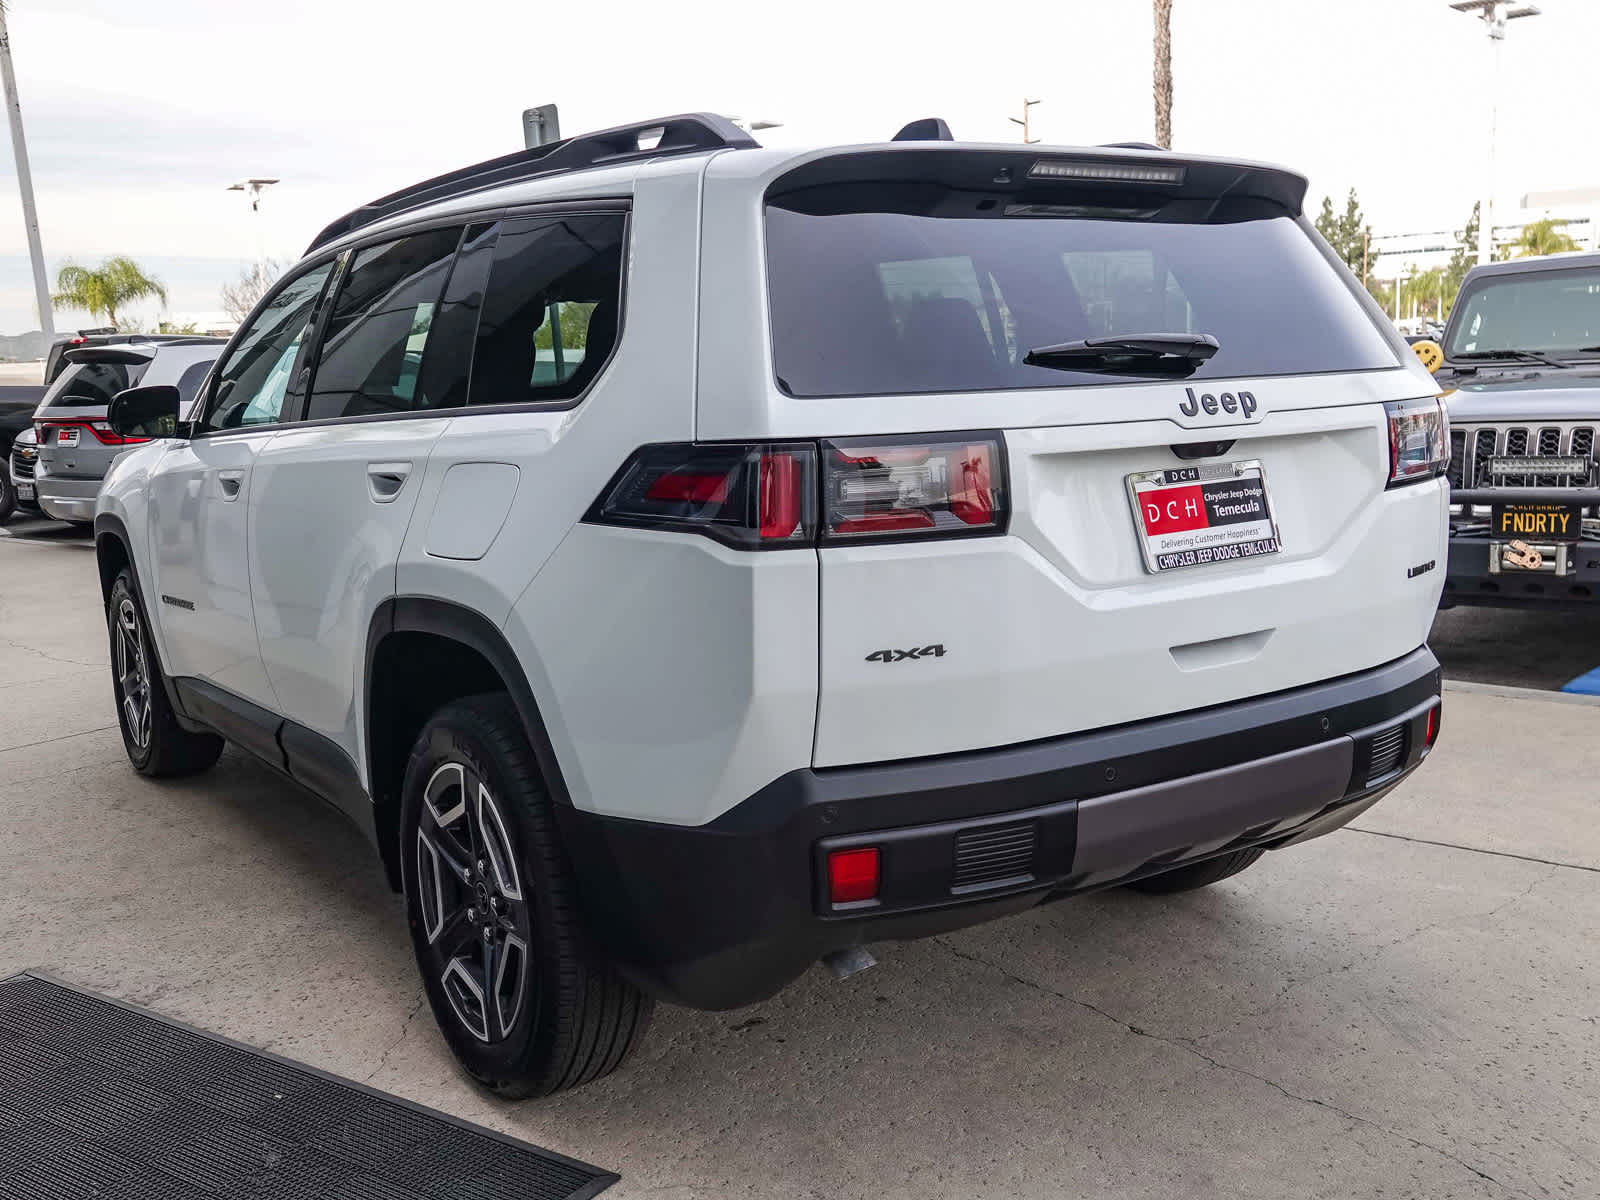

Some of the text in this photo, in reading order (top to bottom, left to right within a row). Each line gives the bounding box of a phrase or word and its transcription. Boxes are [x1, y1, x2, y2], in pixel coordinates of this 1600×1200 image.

[1179, 388, 1258, 419] Jeep
[1203, 487, 1263, 502] Chrysler Jeep Dodge
[1213, 501, 1260, 518] Temecula
[1502, 512, 1570, 533] FNDRTY
[1161, 538, 1194, 549] Delivering
[1195, 533, 1227, 544] Customer
[1159, 540, 1278, 569] CHRYSLER JEEP DODGE TEMECULA
[865, 644, 947, 663] 4x4
